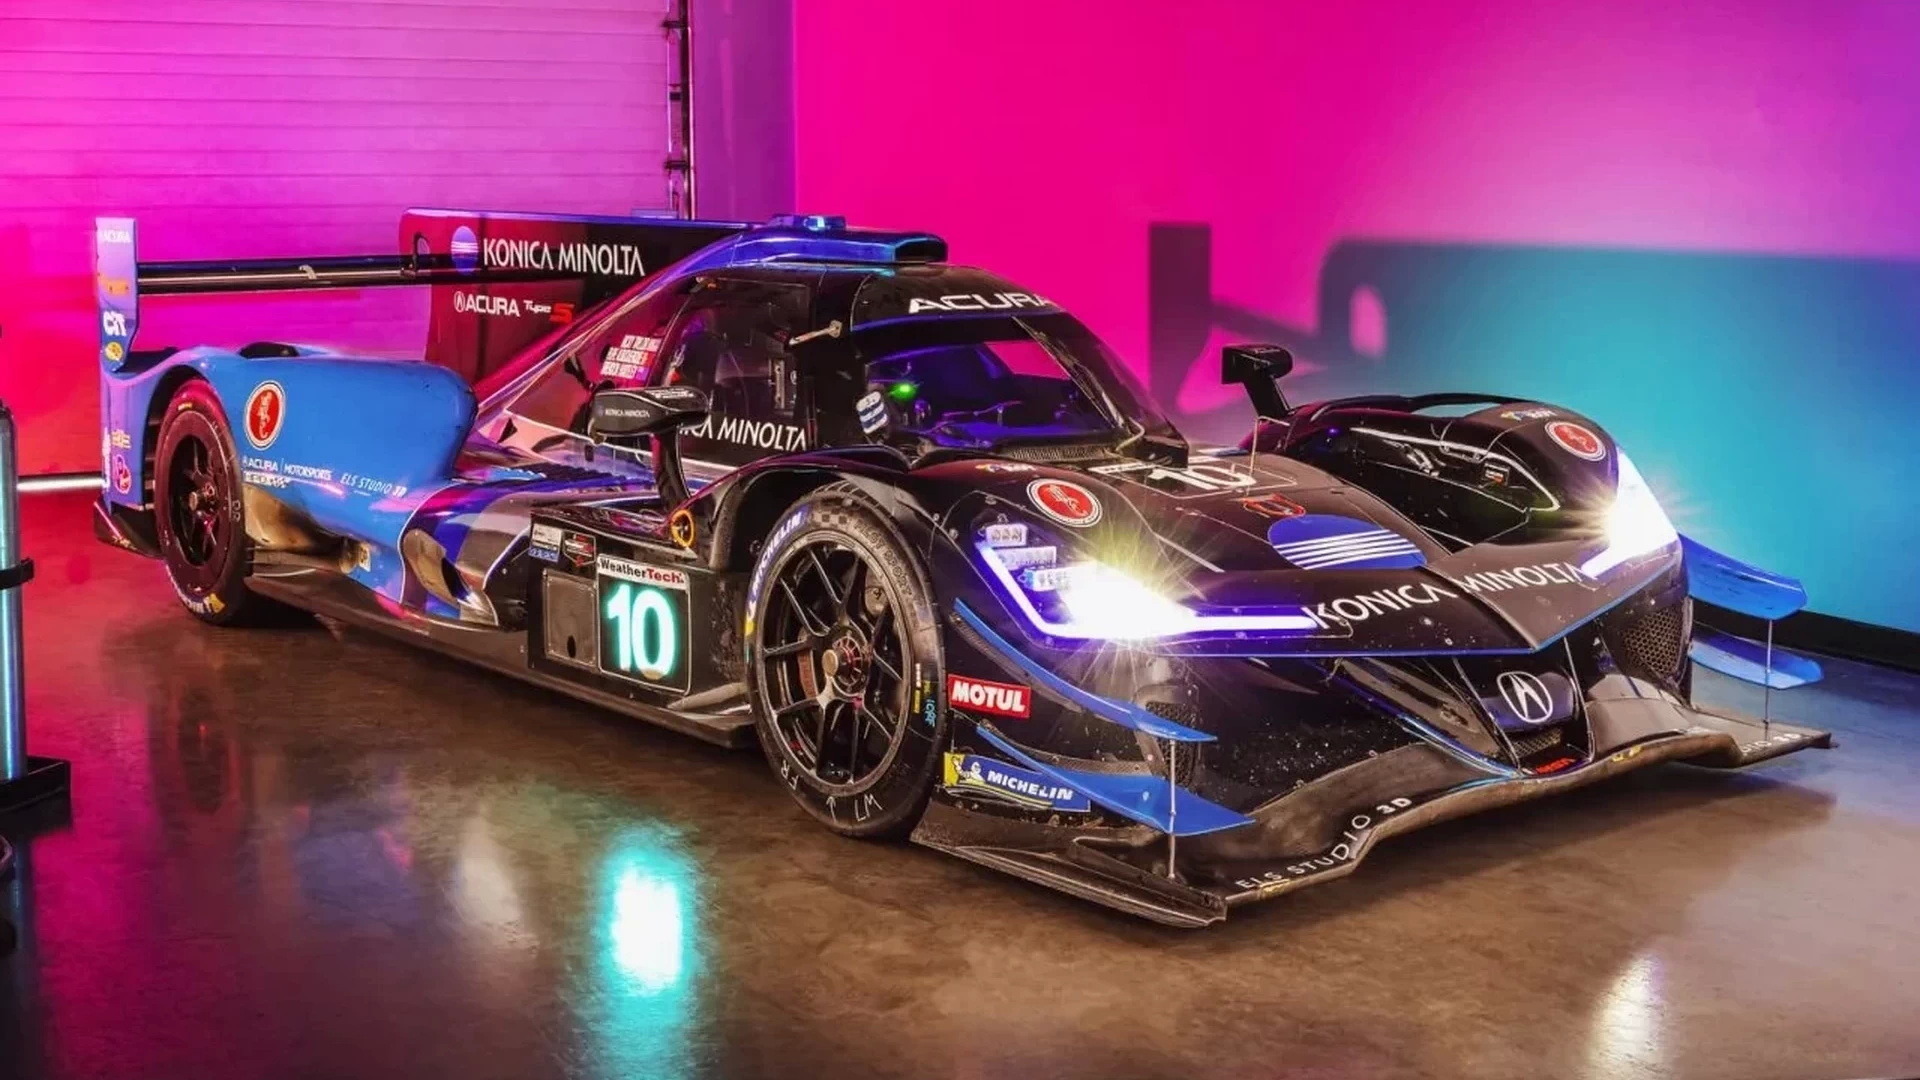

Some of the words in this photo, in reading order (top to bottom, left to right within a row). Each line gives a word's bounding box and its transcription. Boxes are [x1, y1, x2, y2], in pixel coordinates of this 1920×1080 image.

[483, 237, 554, 271] KONICA
[558, 242, 646, 277] MINOLTA
[464, 293, 521, 317] ACURA
[523, 299, 552, 314] Type
[550, 302, 576, 323] S
[716, 416, 808, 451] MINOLTA
[248, 457, 280, 472] ACURA
[284, 463, 334, 481] MOTORSPORTS
[340, 472, 357, 487] ELS
[358, 476, 393, 495] STUDIO
[1301, 582, 1459, 629] KONICA
[1453, 561, 1598, 594] MINOLTA
[606, 582, 677, 681] 10
[951, 680, 1026, 713] MOTUL
[986, 770, 1075, 801] MICHELIN
[1234, 871, 1282, 890] ELS
[1287, 814, 1372, 876] STUDIO
[1375, 797, 1413, 816] 3D
